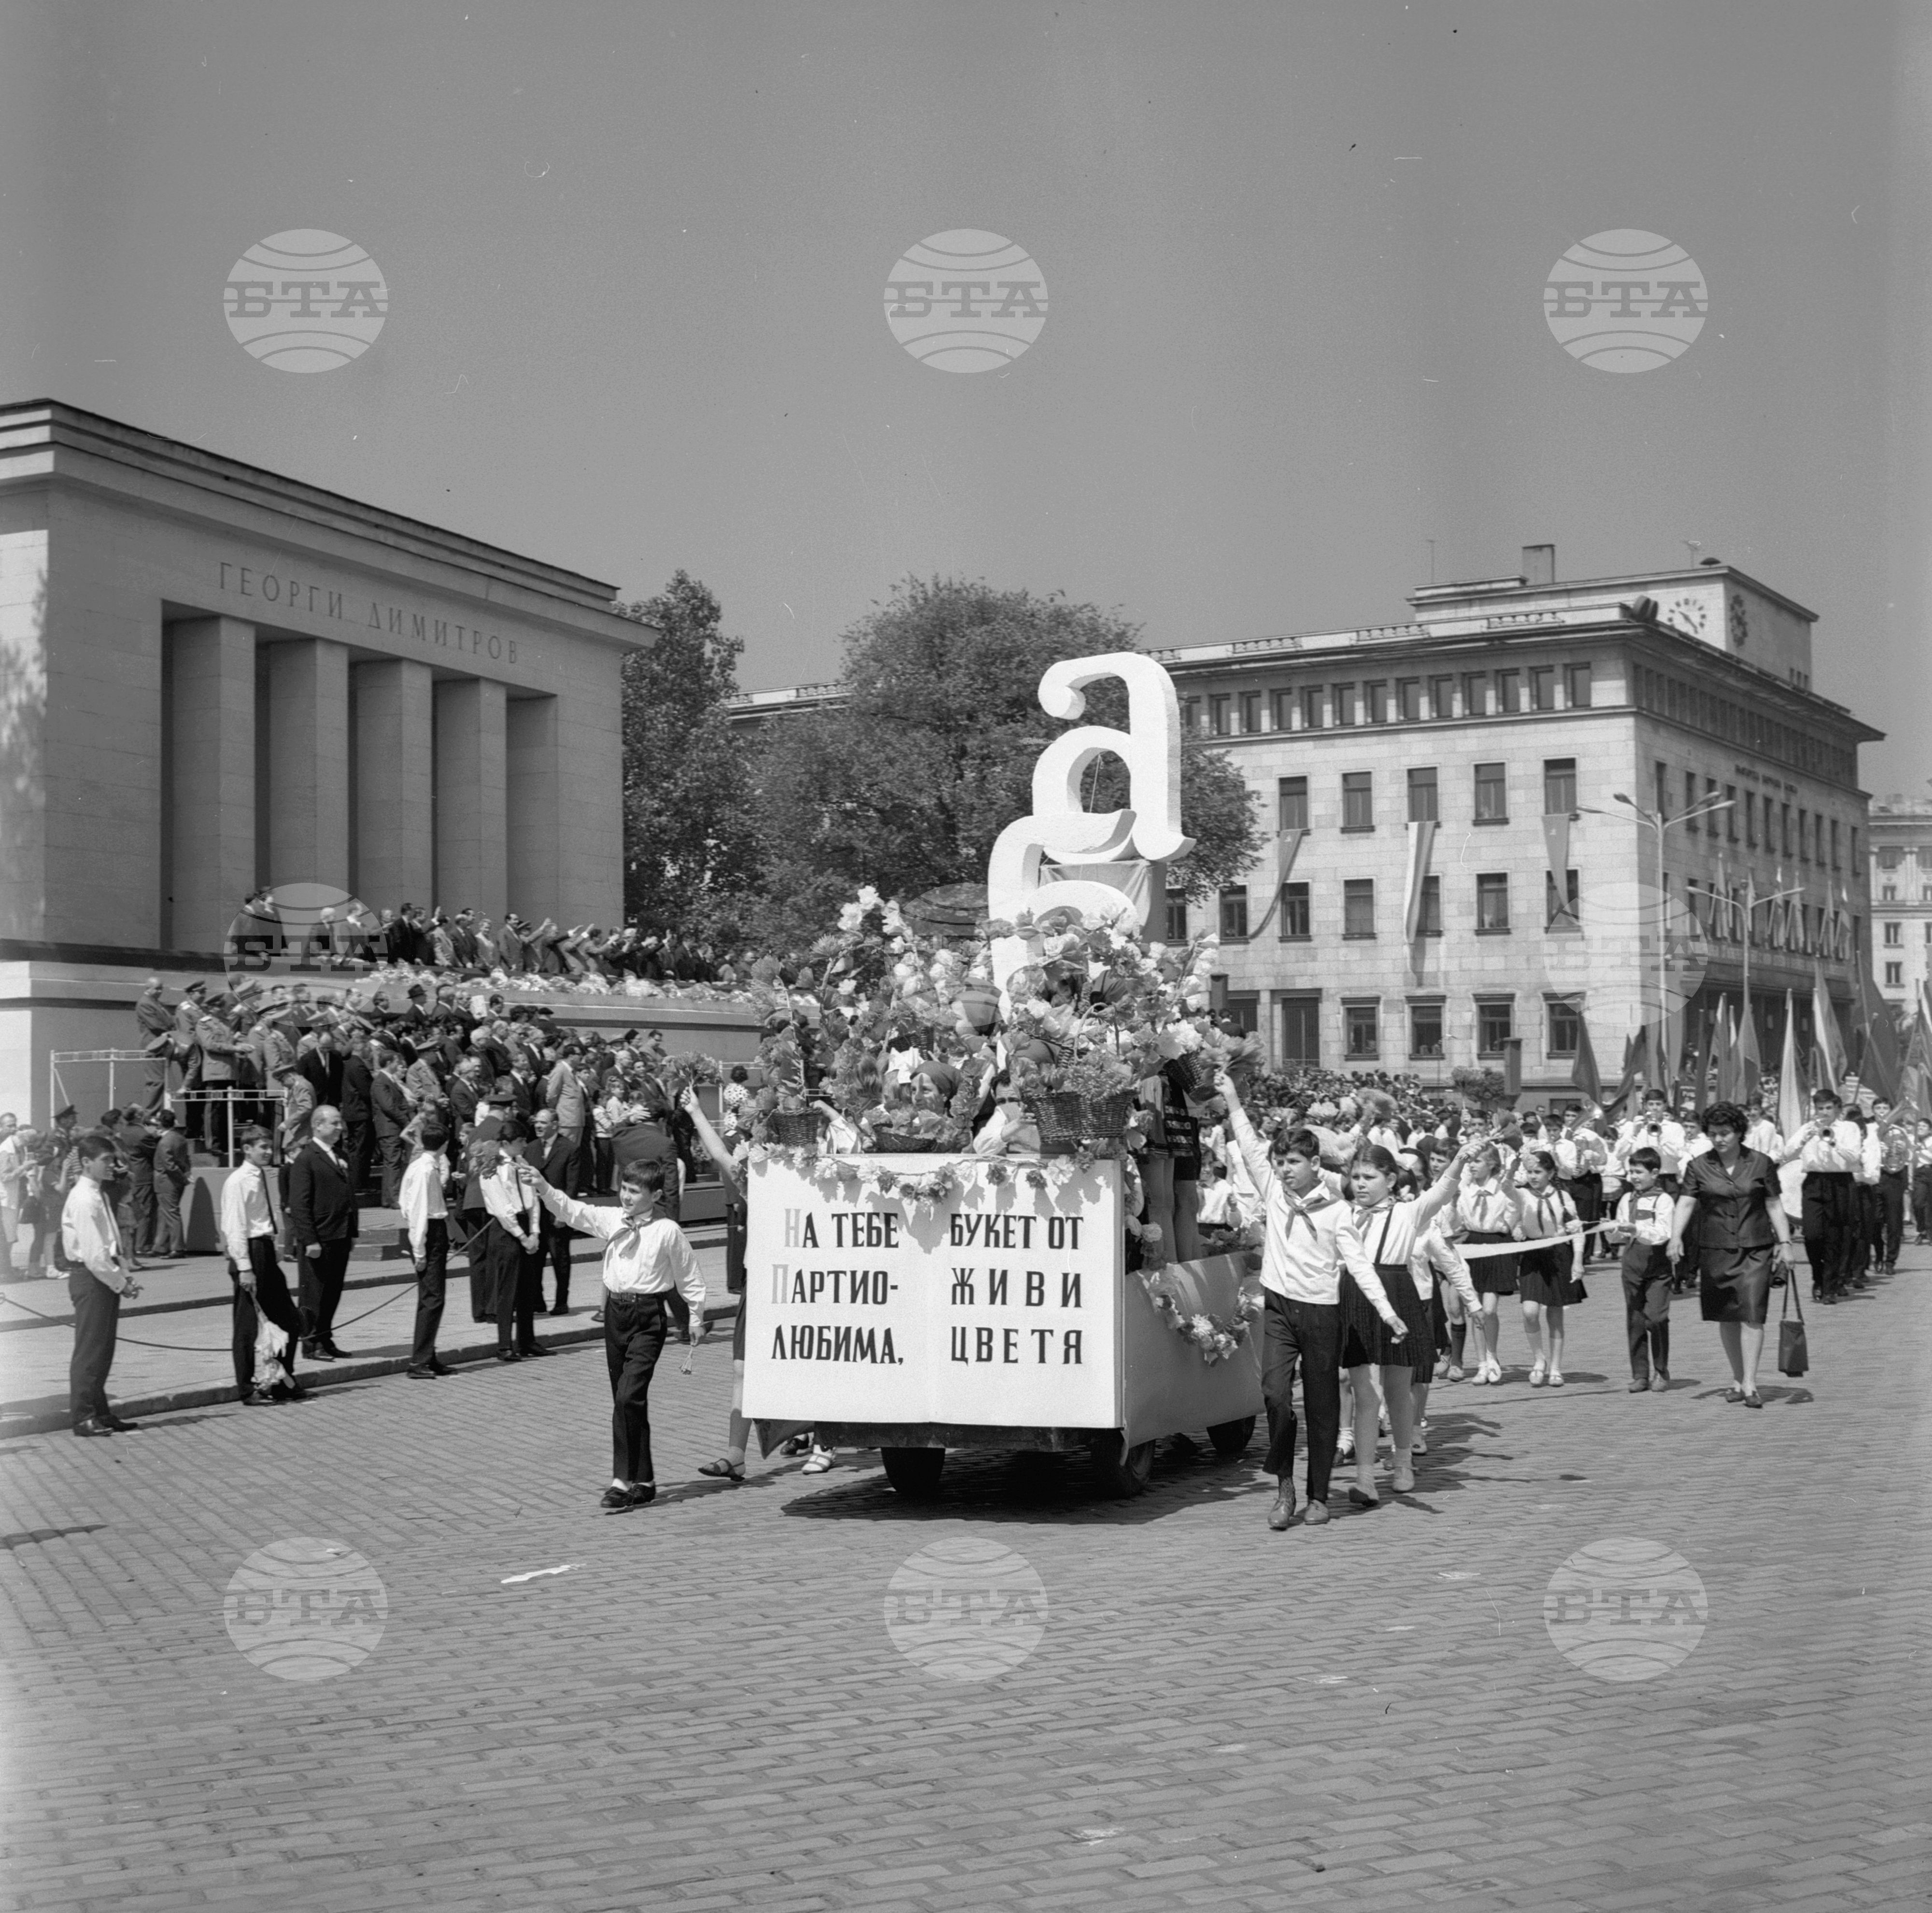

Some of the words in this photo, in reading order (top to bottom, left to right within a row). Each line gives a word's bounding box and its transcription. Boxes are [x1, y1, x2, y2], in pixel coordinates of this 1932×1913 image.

[220, 562, 342, 619] ГЕОРГИ
[368, 602, 517, 664] ДИМИТРОВ
[784, 1208, 820, 1248] НА
[831, 1212, 899, 1248] ТЕБЕ
[950, 1213, 1037, 1249] БУКЕТ
[1048, 1216, 1084, 1250] ОТ
[771, 1263, 899, 1305] ПАРТИО-
[951, 1267, 1082, 1308] ЖИВИ
[771, 1324, 904, 1365] ЛЮБИМА,
[951, 1326, 1082, 1366] ЦВЕТЯ
